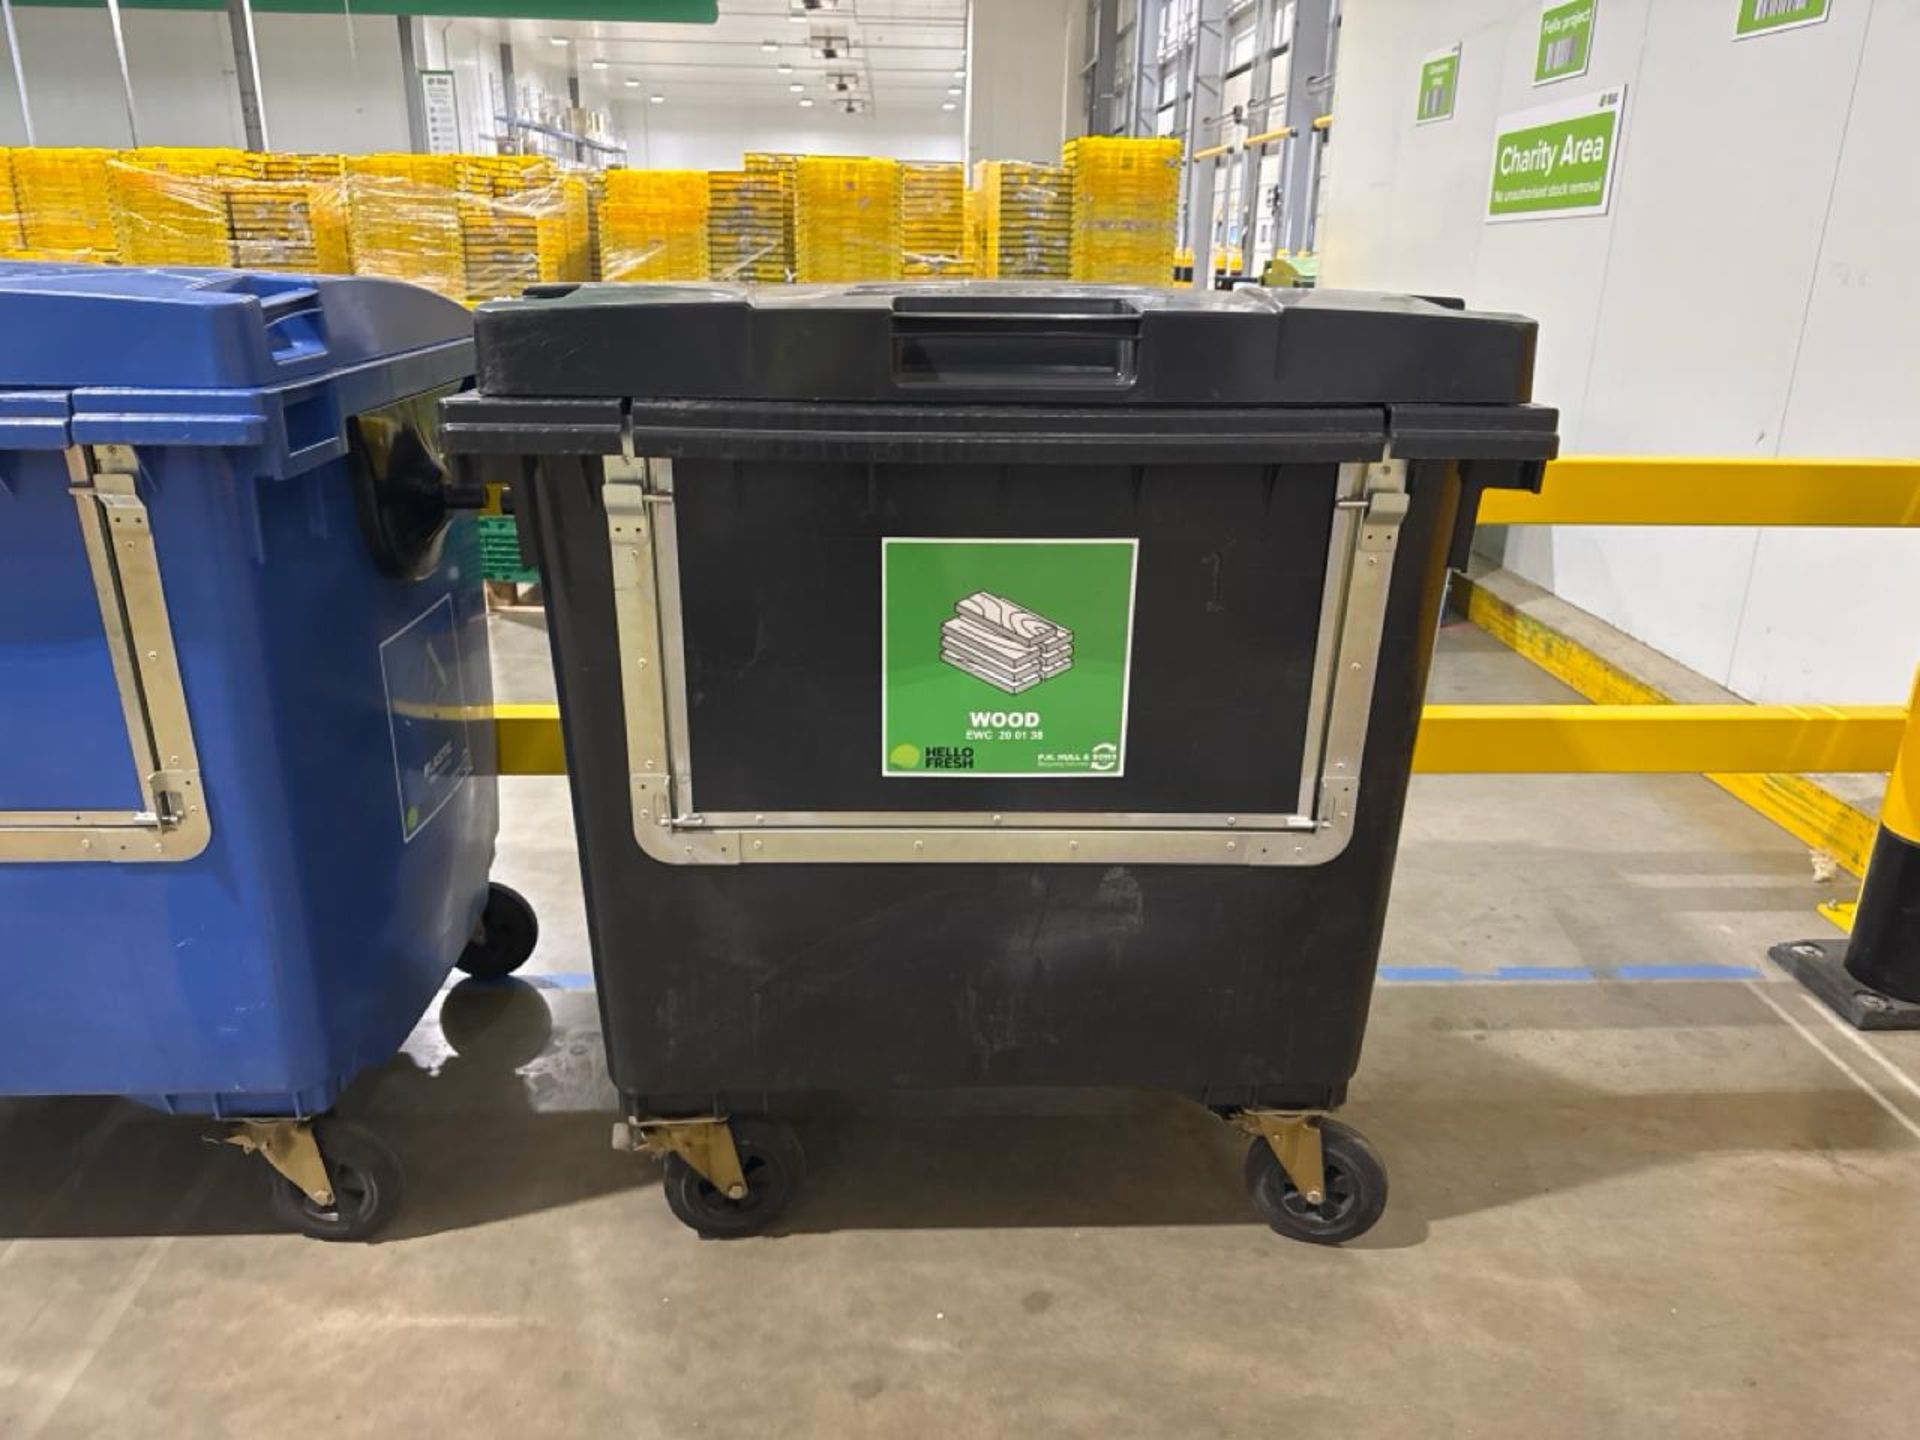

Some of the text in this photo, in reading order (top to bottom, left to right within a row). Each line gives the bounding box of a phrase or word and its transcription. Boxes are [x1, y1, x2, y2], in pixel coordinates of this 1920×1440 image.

[1500, 134, 1605, 177] Charity Area
[969, 712, 1040, 728] WOOD
[965, 730, 993, 741] EWC
[998, 730, 1012, 740] 20
[1014, 730, 1026, 740] 01
[924, 746, 974, 758] HELLO
[924, 757, 974, 769] FRESH
